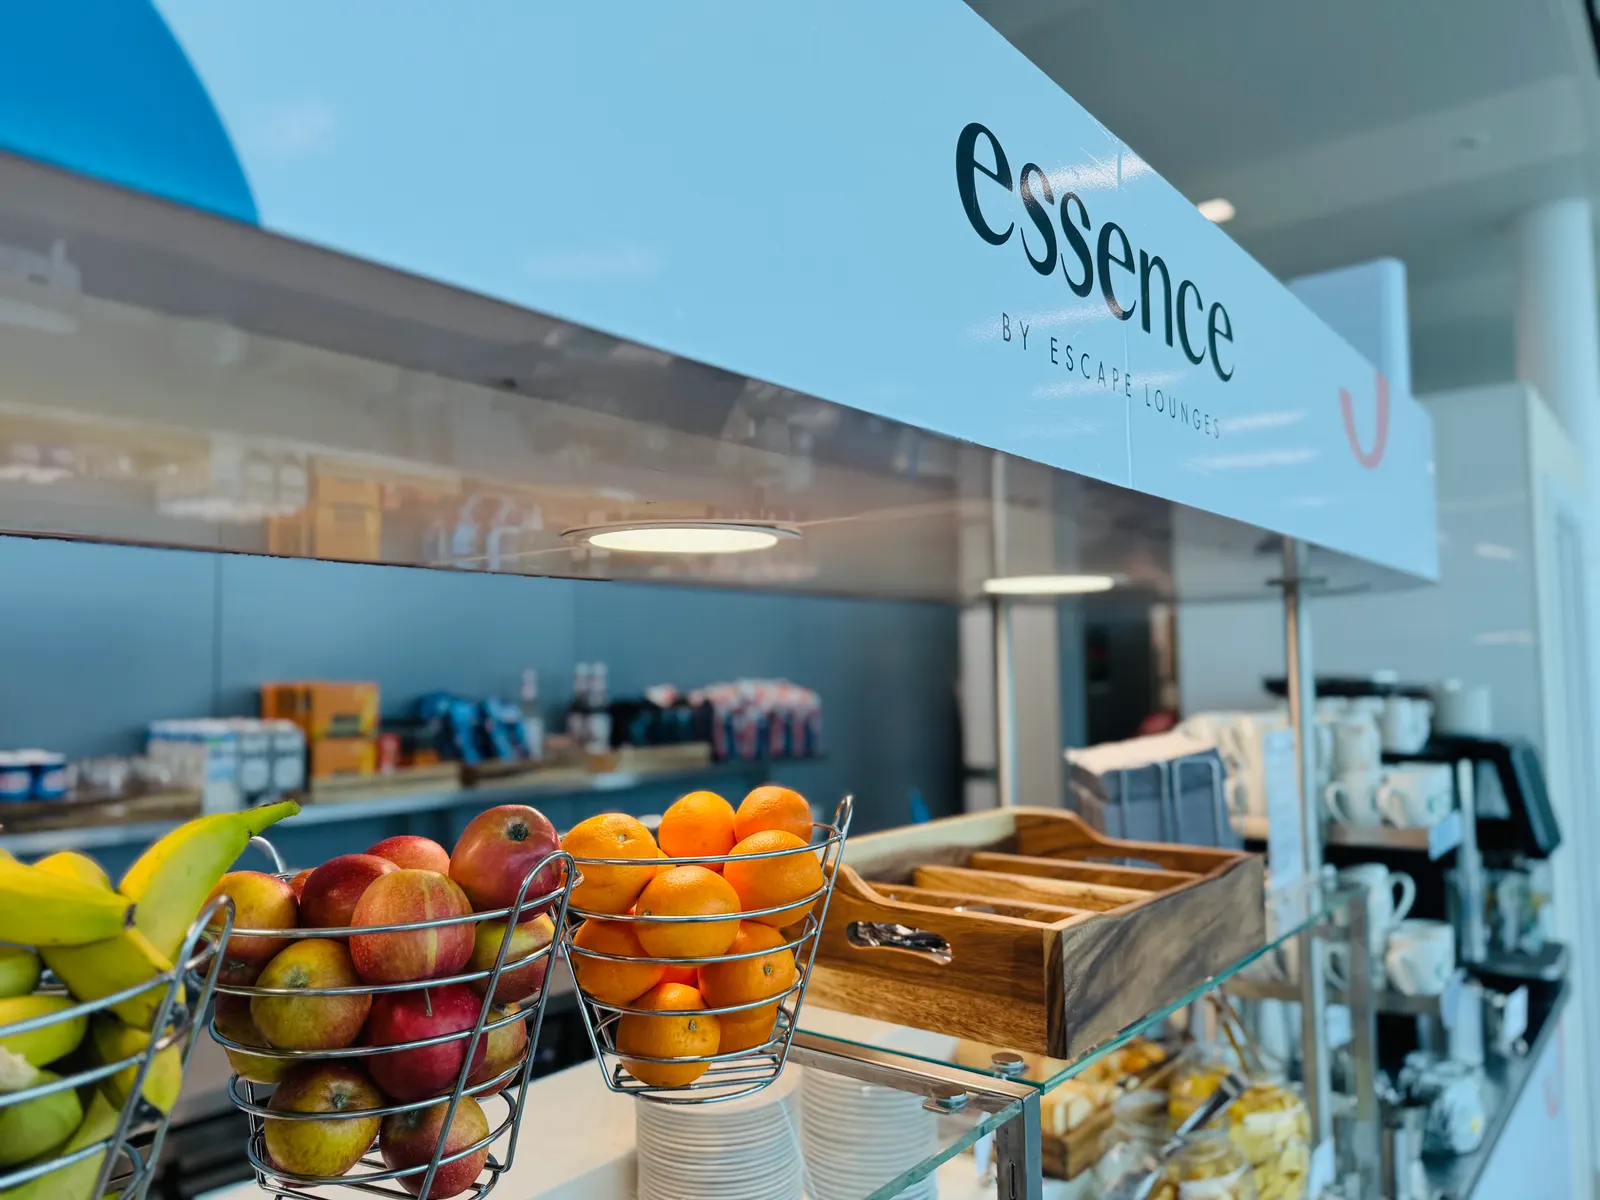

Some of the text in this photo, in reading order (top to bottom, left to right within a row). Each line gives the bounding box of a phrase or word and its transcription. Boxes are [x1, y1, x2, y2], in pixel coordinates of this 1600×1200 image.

[956, 122, 1235, 382] essence
[1002, 312, 1220, 440] BY ESCAPE LOUNGES
